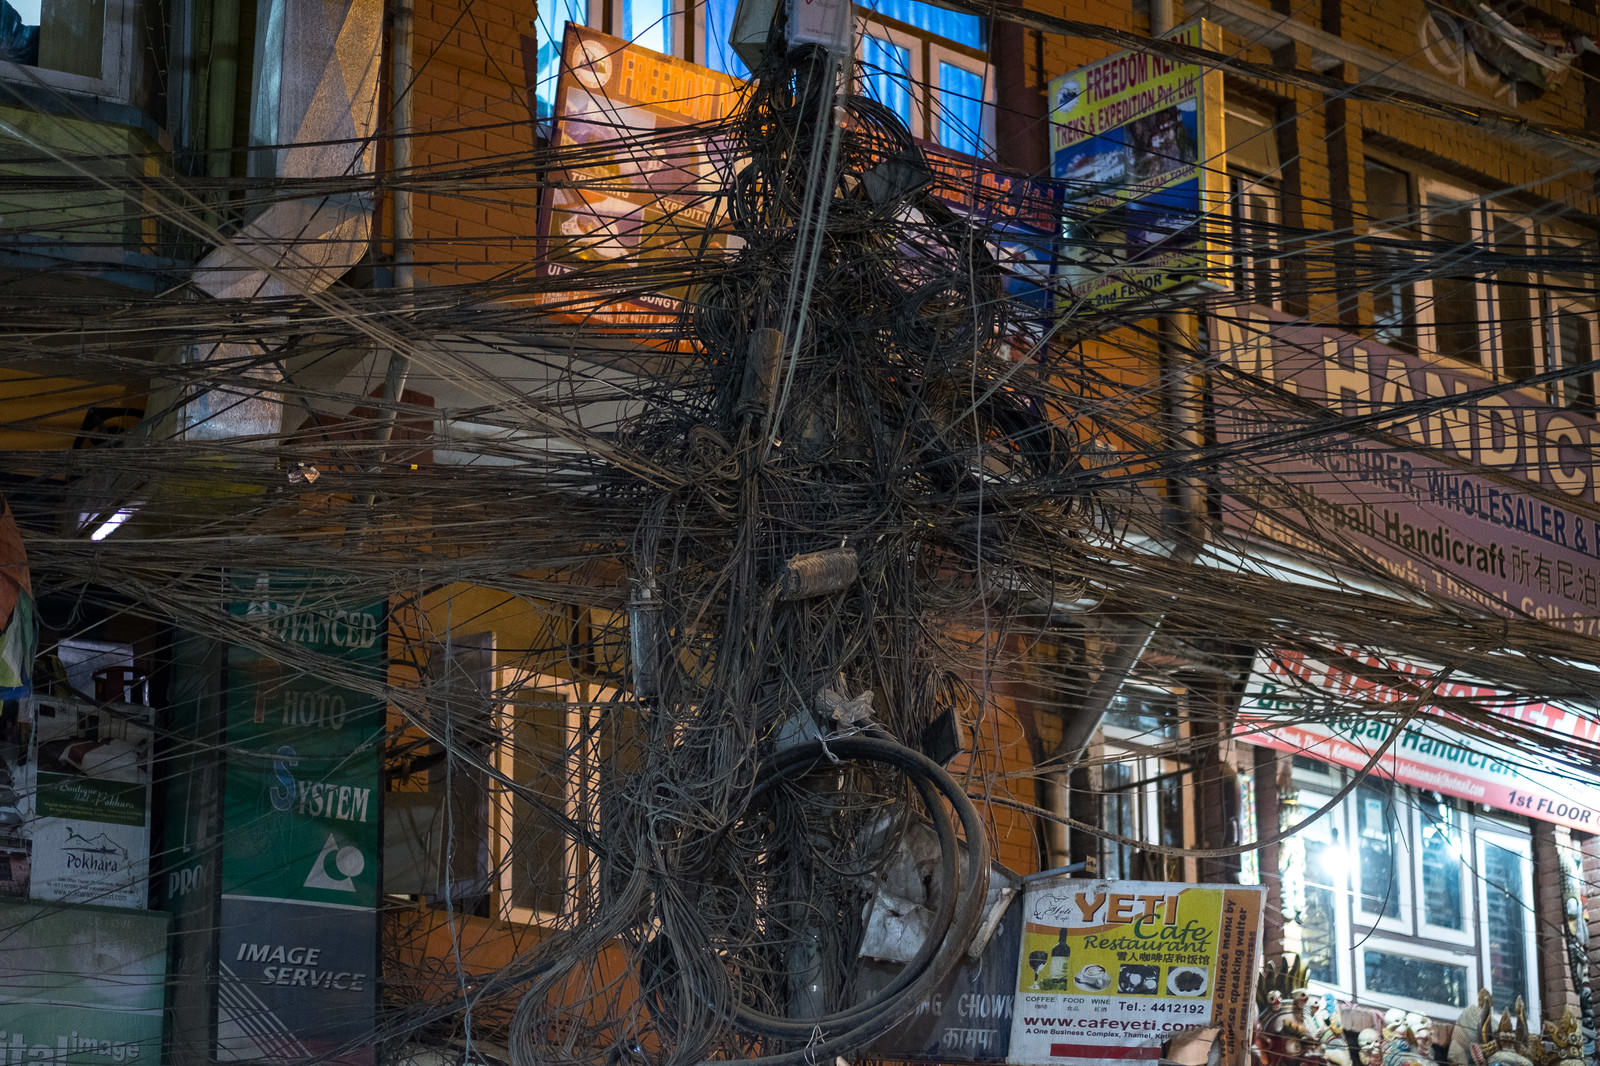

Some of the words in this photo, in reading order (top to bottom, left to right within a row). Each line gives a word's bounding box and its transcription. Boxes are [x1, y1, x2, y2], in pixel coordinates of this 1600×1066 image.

[619, 50, 716, 121] FREEDOM
[1085, 52, 1150, 104] FREEDOM
[1055, 115, 1087, 147] TREKS
[1088, 112, 1096, 137] &
[1098, 90, 1155, 130] EXPEDITION
[1322, 335, 1600, 506] HANDIC
[1426, 469, 1567, 548] WHOLESALER
[1574, 516, 1588, 552] &
[1384, 508, 1507, 579] Handicraft
[1511, 544, 1600, 609] 所有尼泊
[253, 657, 346, 730] PHOTO
[269, 745, 372, 823] SYSTEM
[1508, 789, 1532, 809] 1st
[1537, 798, 1592, 824] FLOOR
[66, 852, 118, 872] Pokhara
[1074, 892, 1179, 925] YETI
[1224, 899, 1237, 914] by
[1083, 934, 1212, 953] Restaurant
[1133, 913, 1214, 945] Cafe
[1219, 916, 1234, 949] menu
[1234, 908, 1248, 946] waiter
[236, 942, 321, 966] IMAGE
[259, 966, 368, 991] SERVICE
[1229, 949, 1246, 1004] speaking
[957, 992, 1014, 1018] CHOWK
[1118, 1001, 1146, 1012] Tel.:
[1150, 1003, 1205, 1014] 4412192
[1023, 1016, 1201, 1033] www.cafeyeti.com
[1086, 1031, 1122, 1039] Complex,
[1124, 1032, 1153, 1040] Thamel,
[71, 1031, 140, 1061] image
